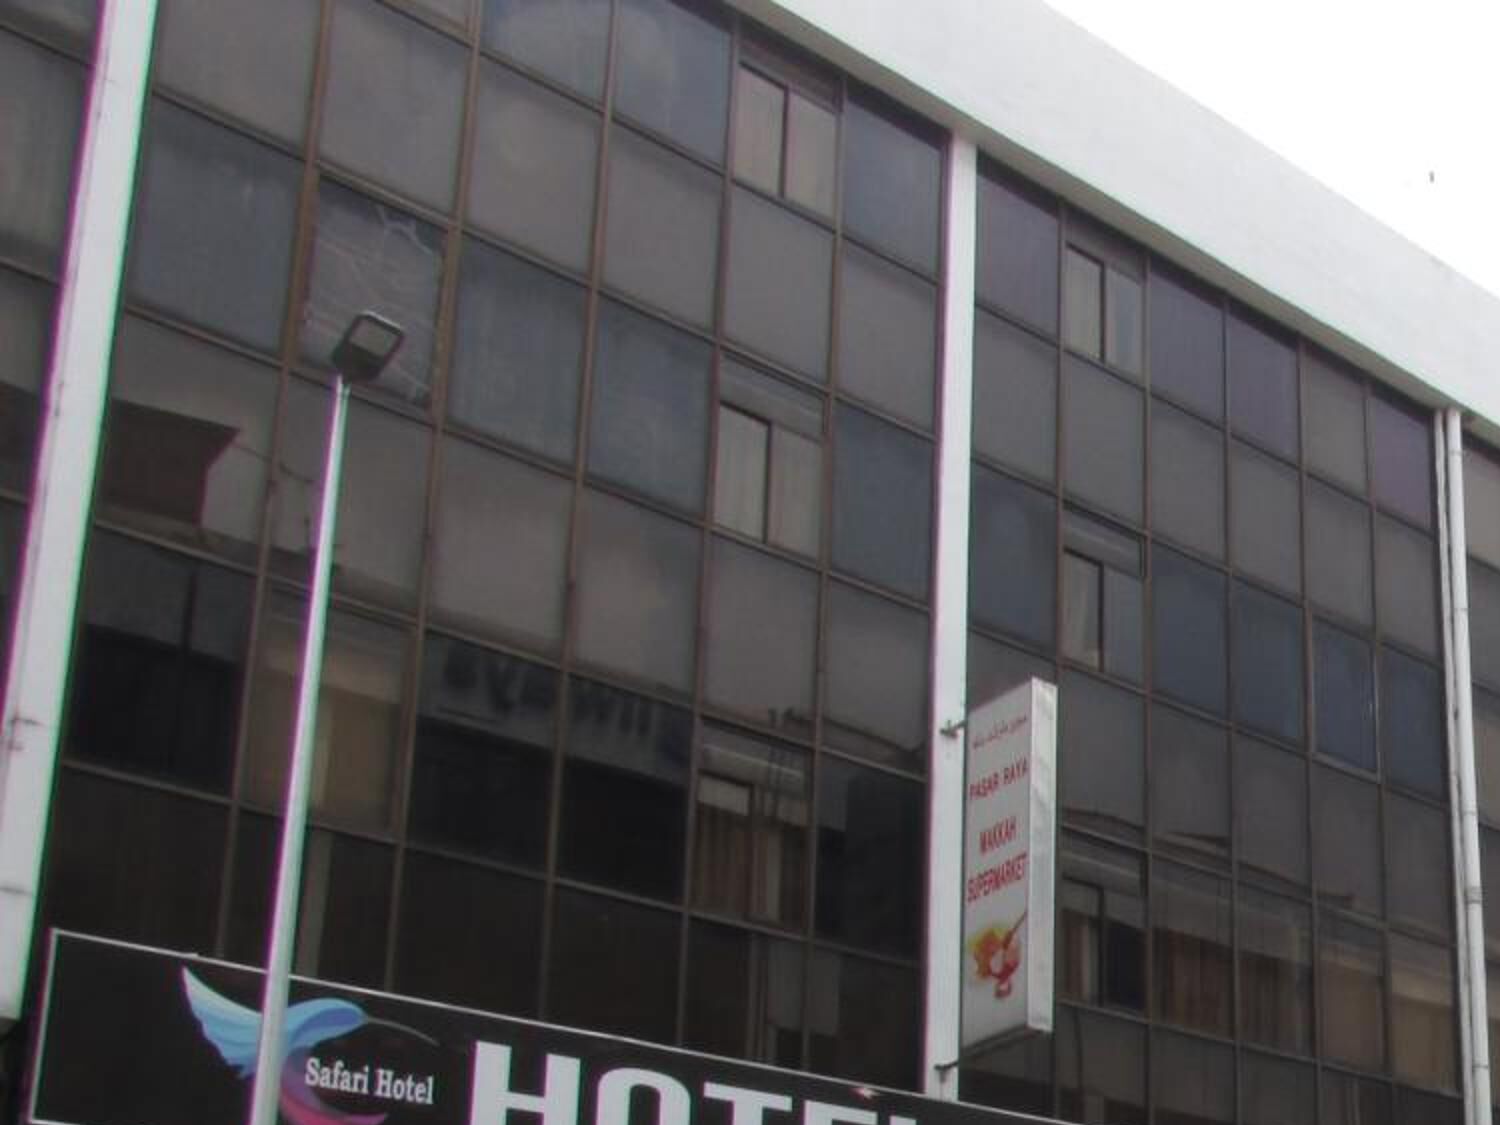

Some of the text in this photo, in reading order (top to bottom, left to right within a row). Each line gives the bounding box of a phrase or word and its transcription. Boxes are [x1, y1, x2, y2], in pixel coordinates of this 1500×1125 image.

[1002, 755, 1028, 787] RAYA
[967, 854, 1027, 902] SUPERMARKET
[304, 1056, 434, 1106] Safari Hotel
